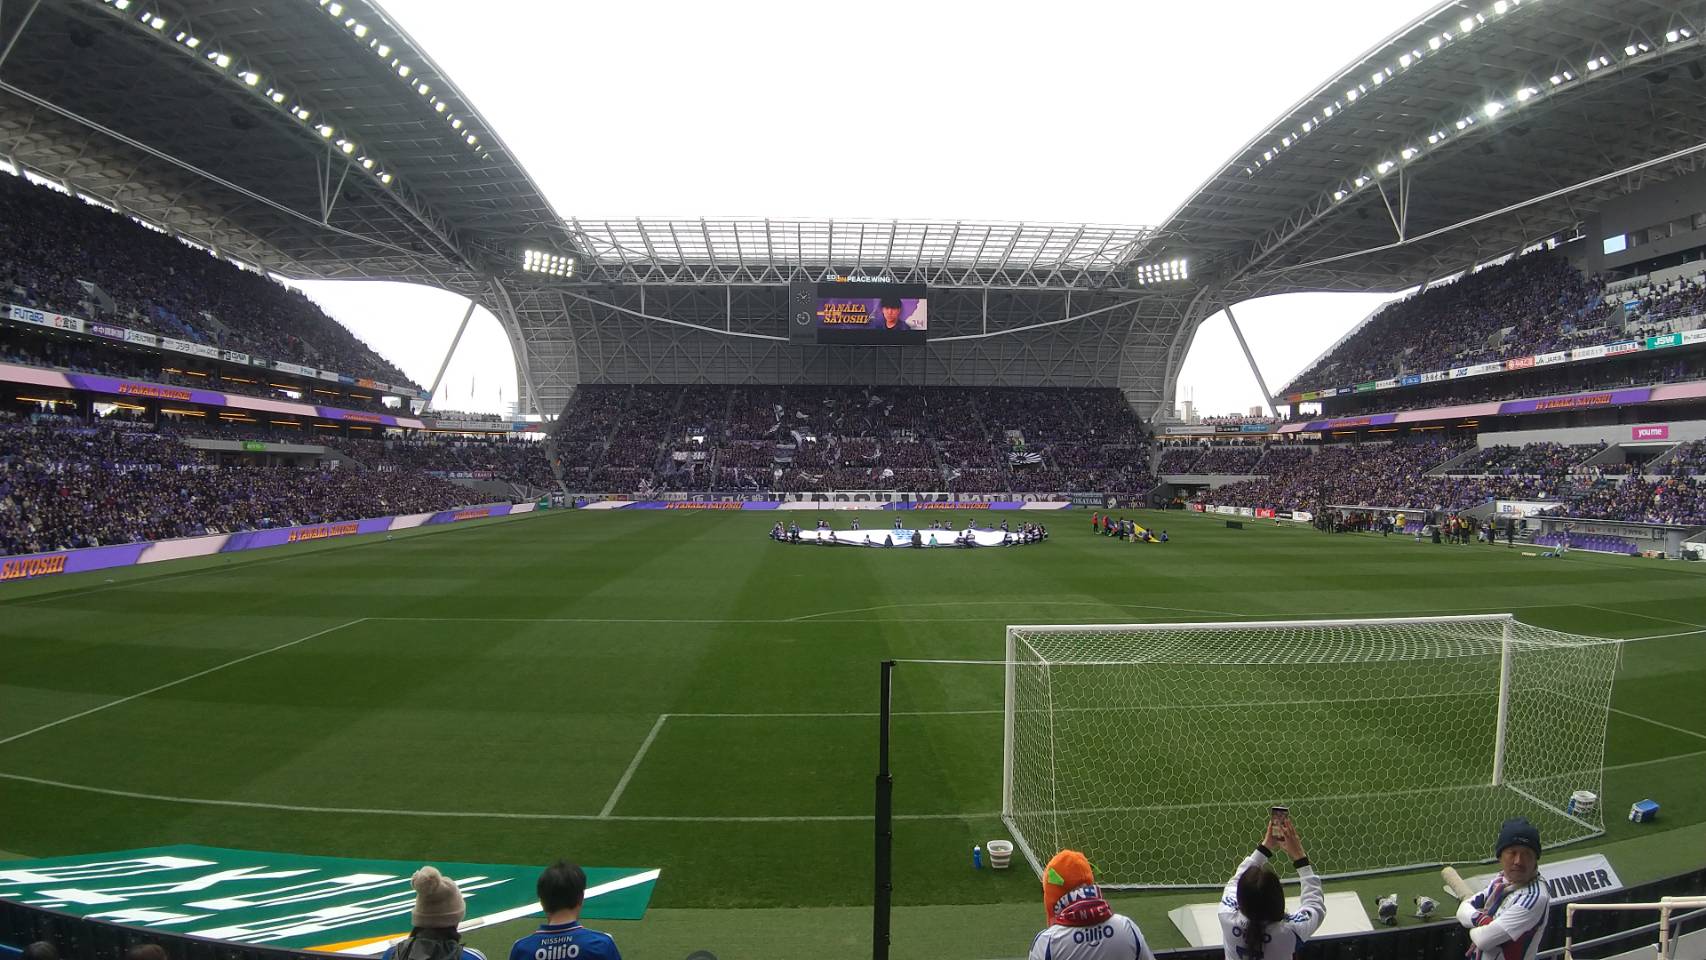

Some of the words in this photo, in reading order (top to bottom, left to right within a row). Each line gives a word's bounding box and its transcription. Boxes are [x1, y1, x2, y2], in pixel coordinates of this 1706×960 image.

[823, 304, 866, 313] TANAKA
[823, 314, 869, 324] SATOSHI
[1654, 335, 1675, 345] JSW
[299, 527, 329, 541] TANAKA
[330, 521, 359, 537] SATOSHI
[0, 555, 67, 580] SATOSHI
[541, 935, 573, 946] NISSHIN
